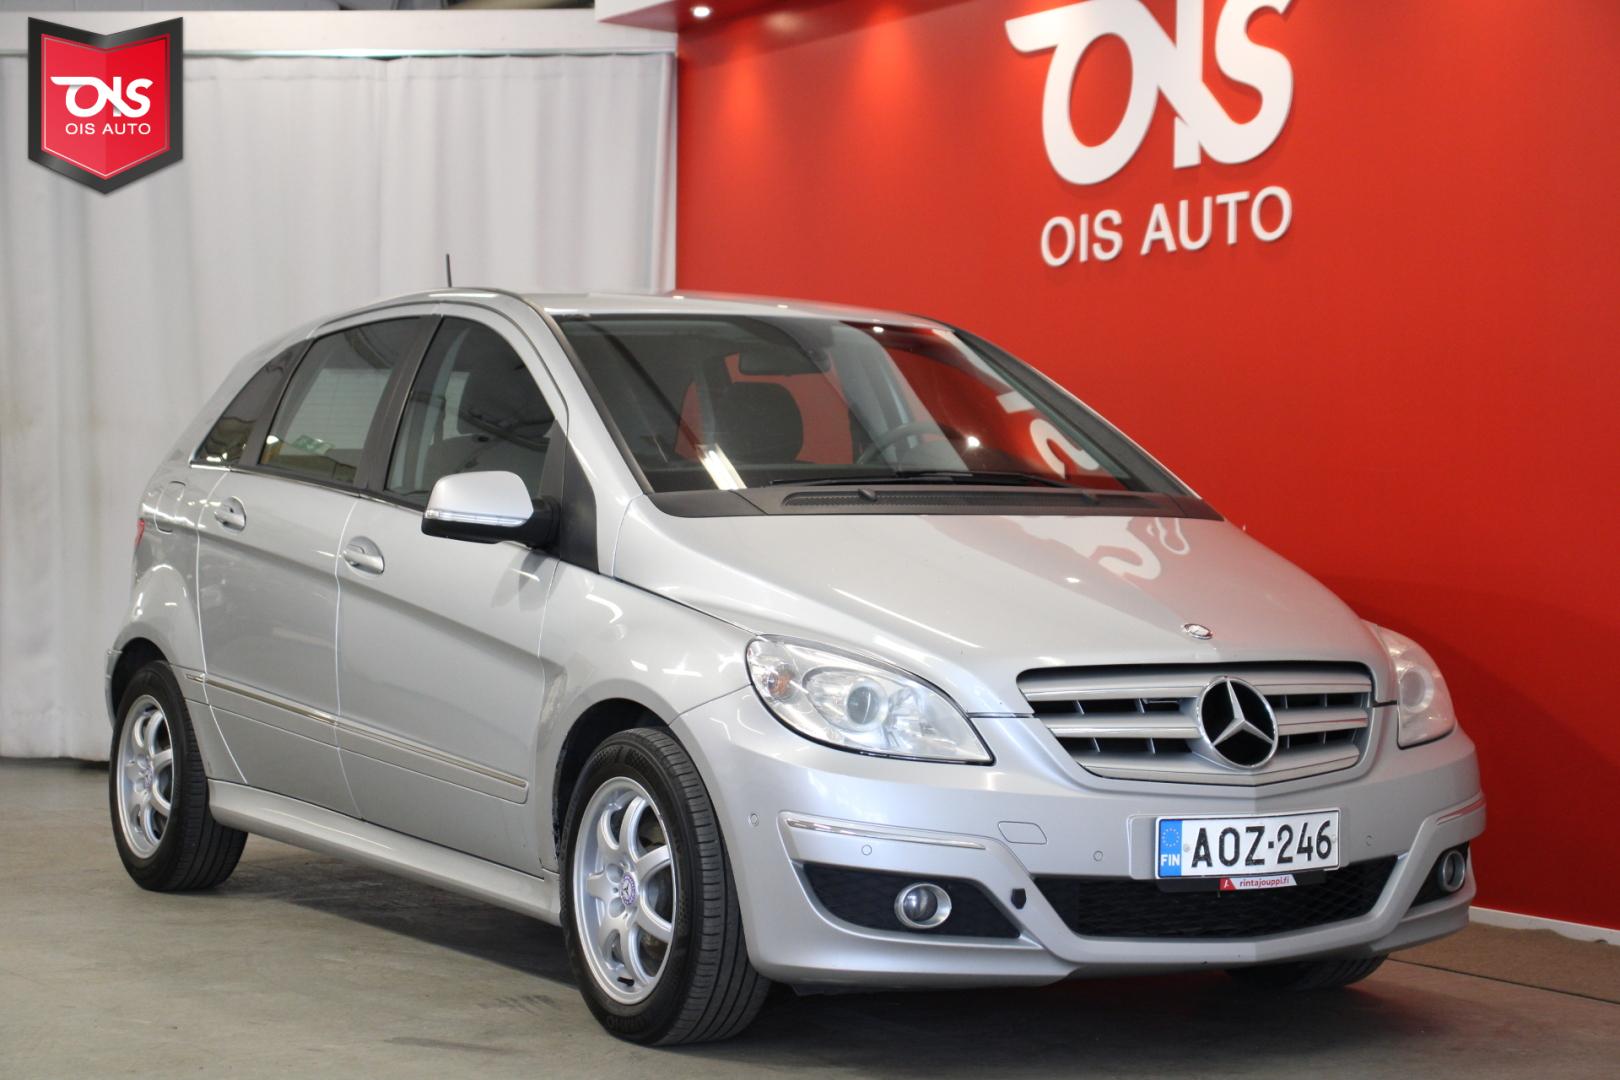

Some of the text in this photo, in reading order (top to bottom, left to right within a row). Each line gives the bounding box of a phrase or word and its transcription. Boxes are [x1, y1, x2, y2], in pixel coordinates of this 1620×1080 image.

[1041, 186, 1293, 267] OIS AUTO
[1191, 820, 1332, 868] AOZ-246
[1160, 854, 1180, 867] FIN
[1239, 877, 1290, 889] rintajouppi.fi
